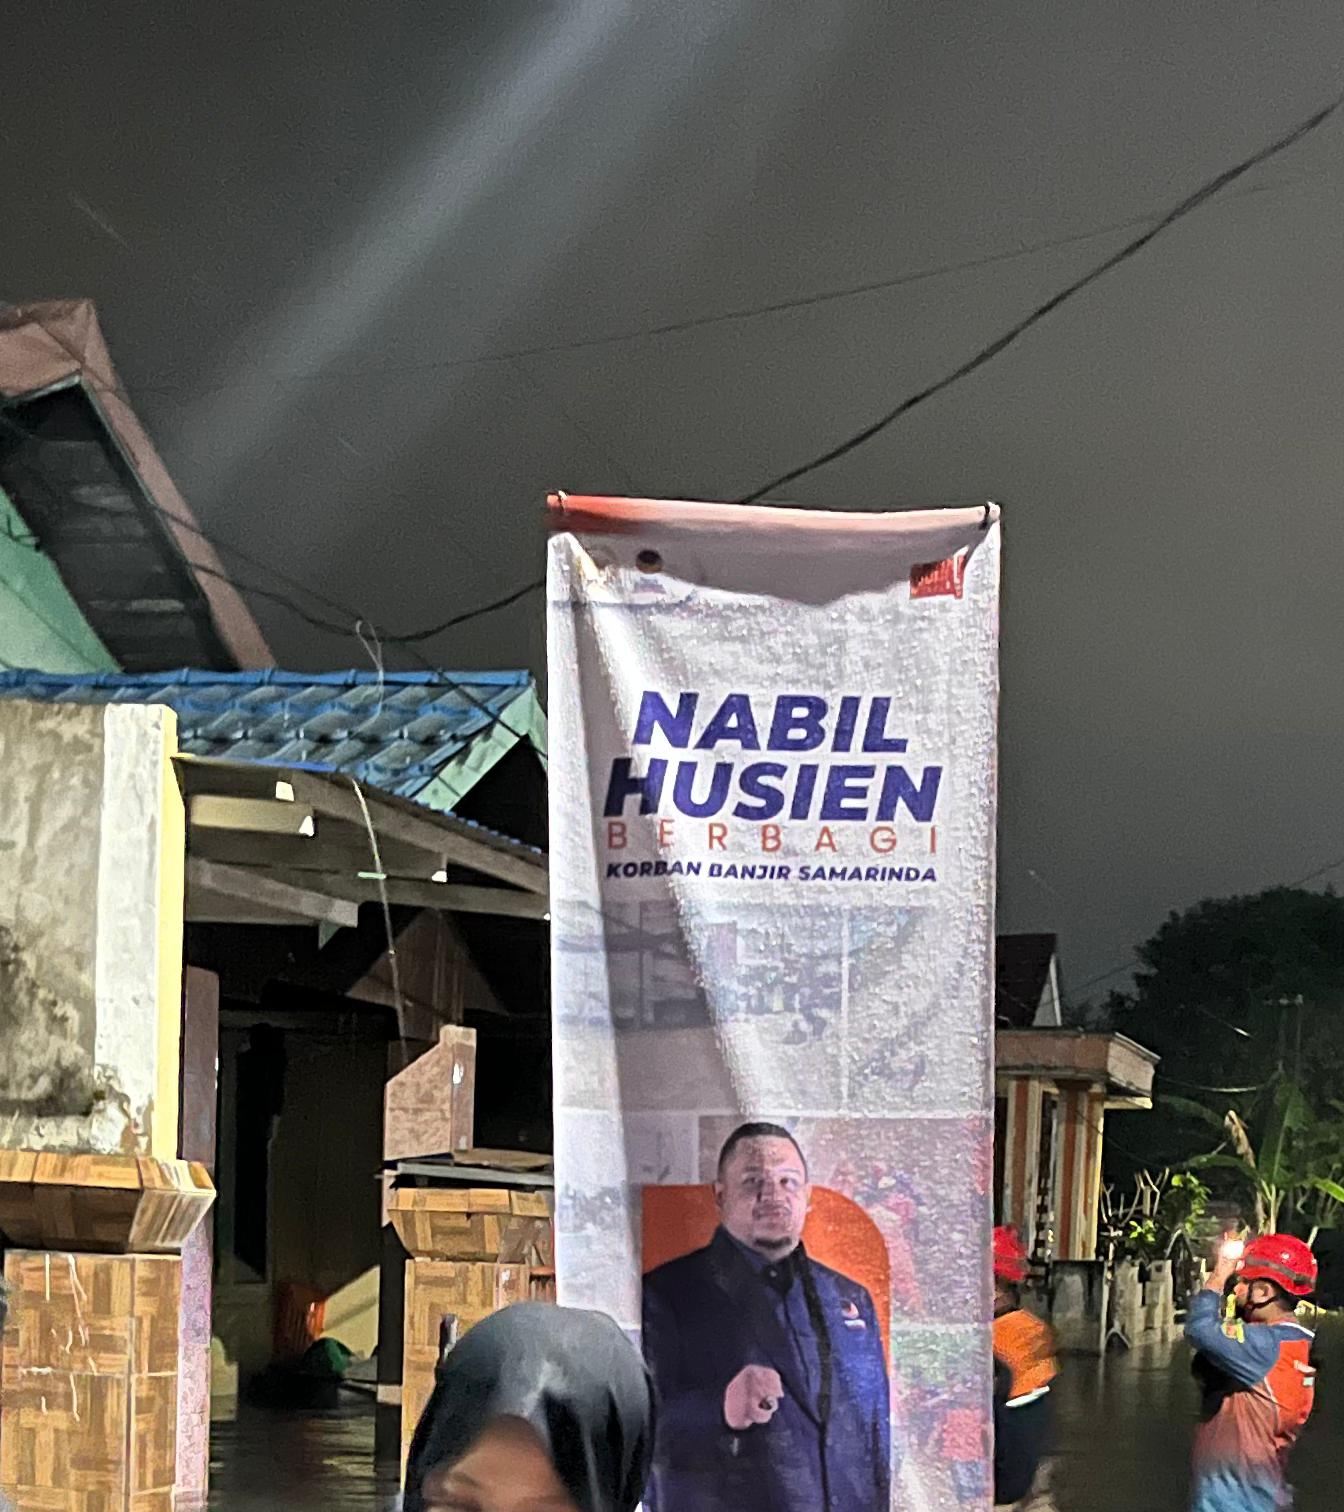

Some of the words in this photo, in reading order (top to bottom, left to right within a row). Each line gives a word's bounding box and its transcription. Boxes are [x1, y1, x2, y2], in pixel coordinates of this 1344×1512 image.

[632, 690, 909, 754] NABIL
[604, 757, 943, 822] HUSIEN
[607, 818, 937, 853] BERBAGI
[606, 860, 702, 879] KORBAN
[708, 863, 792, 881] BANJIR
[798, 865, 937, 882] SAMARINDA
